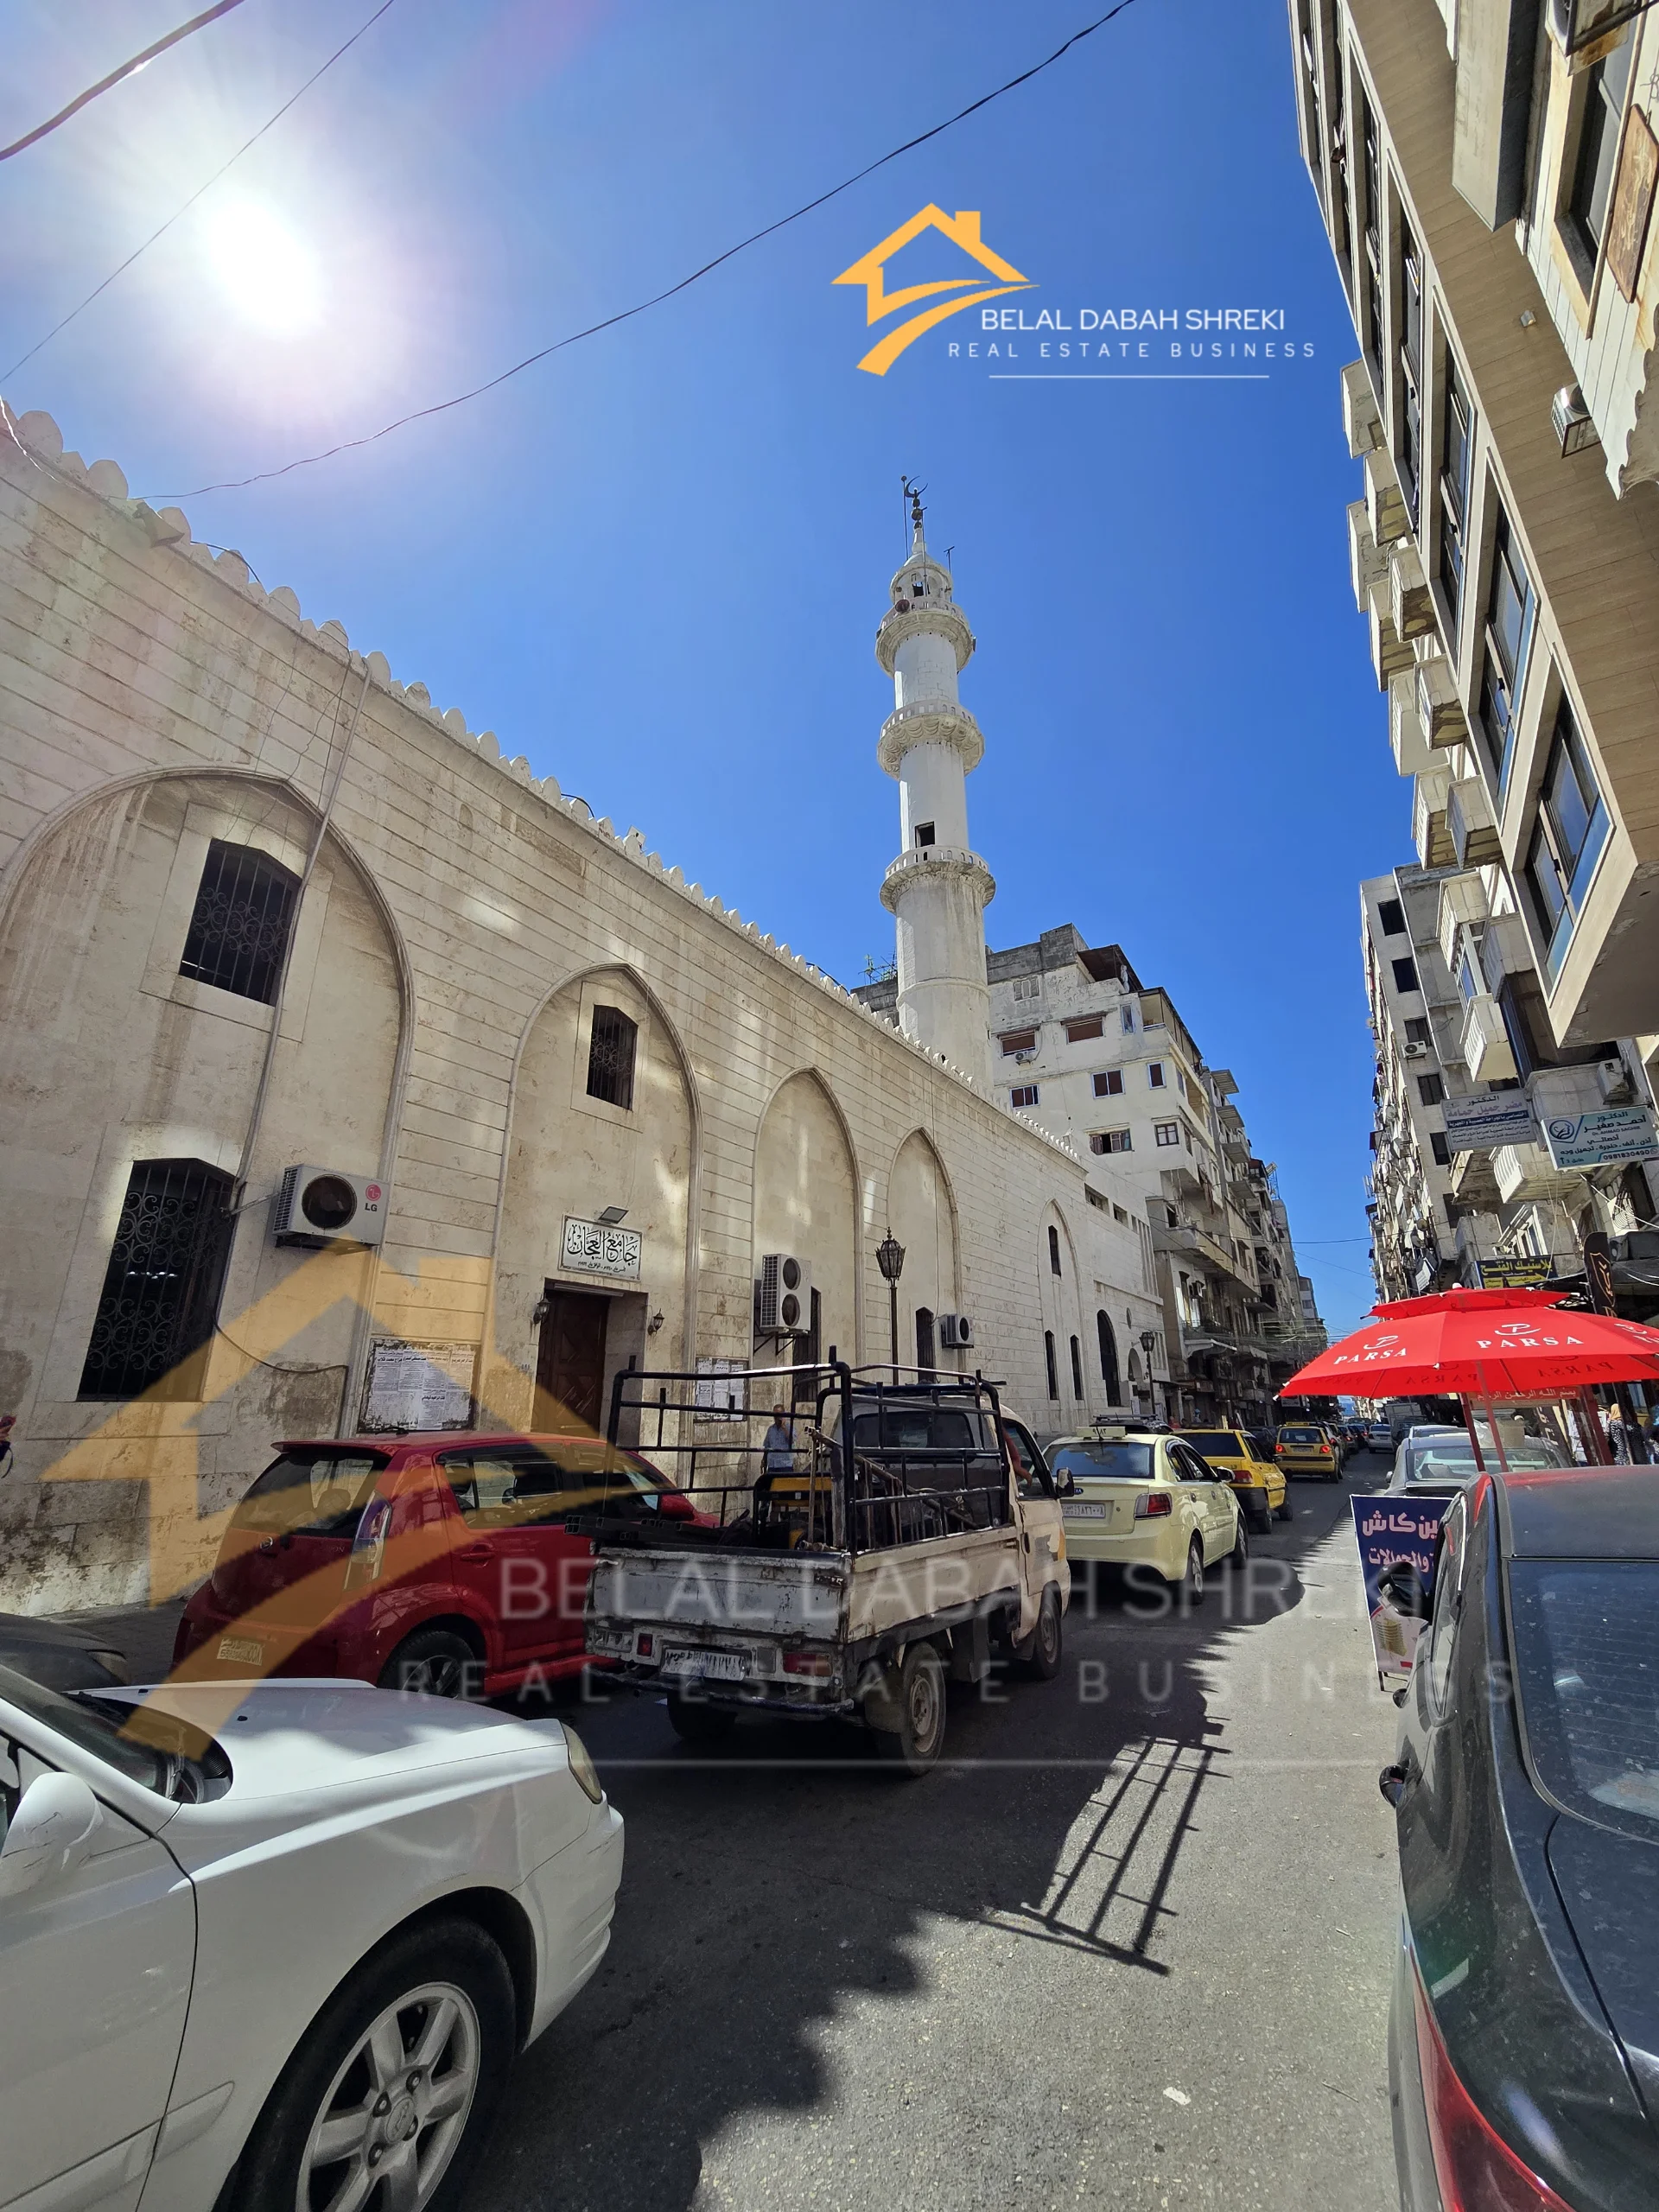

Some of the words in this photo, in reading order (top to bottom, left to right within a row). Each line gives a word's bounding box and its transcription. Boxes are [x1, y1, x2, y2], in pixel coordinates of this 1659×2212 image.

[1467, 1096, 1499, 1106] الدكتور
[1477, 1105, 1499, 1116] جميل
[1597, 1111, 1628, 1122] الدكتور
[1616, 1115, 1646, 1127] أحمد
[1583, 1122, 1614, 1133] صغير
[1587, 1135, 1619, 1145] أخصائي
[1574, 1145, 1595, 1154] تجميل
[365, 1203, 378, 1211] LG
[1515, 1258, 1553, 1272] بلاستيك
[1476, 1336, 1584, 1349] PARSA
[1334, 1348, 1407, 1365] PARSA
[1505, 1389, 1536, 1399] الرحمن
[1539, 1388, 1556, 1397] الله
[1362, 1510, 1416, 1536] كاش
